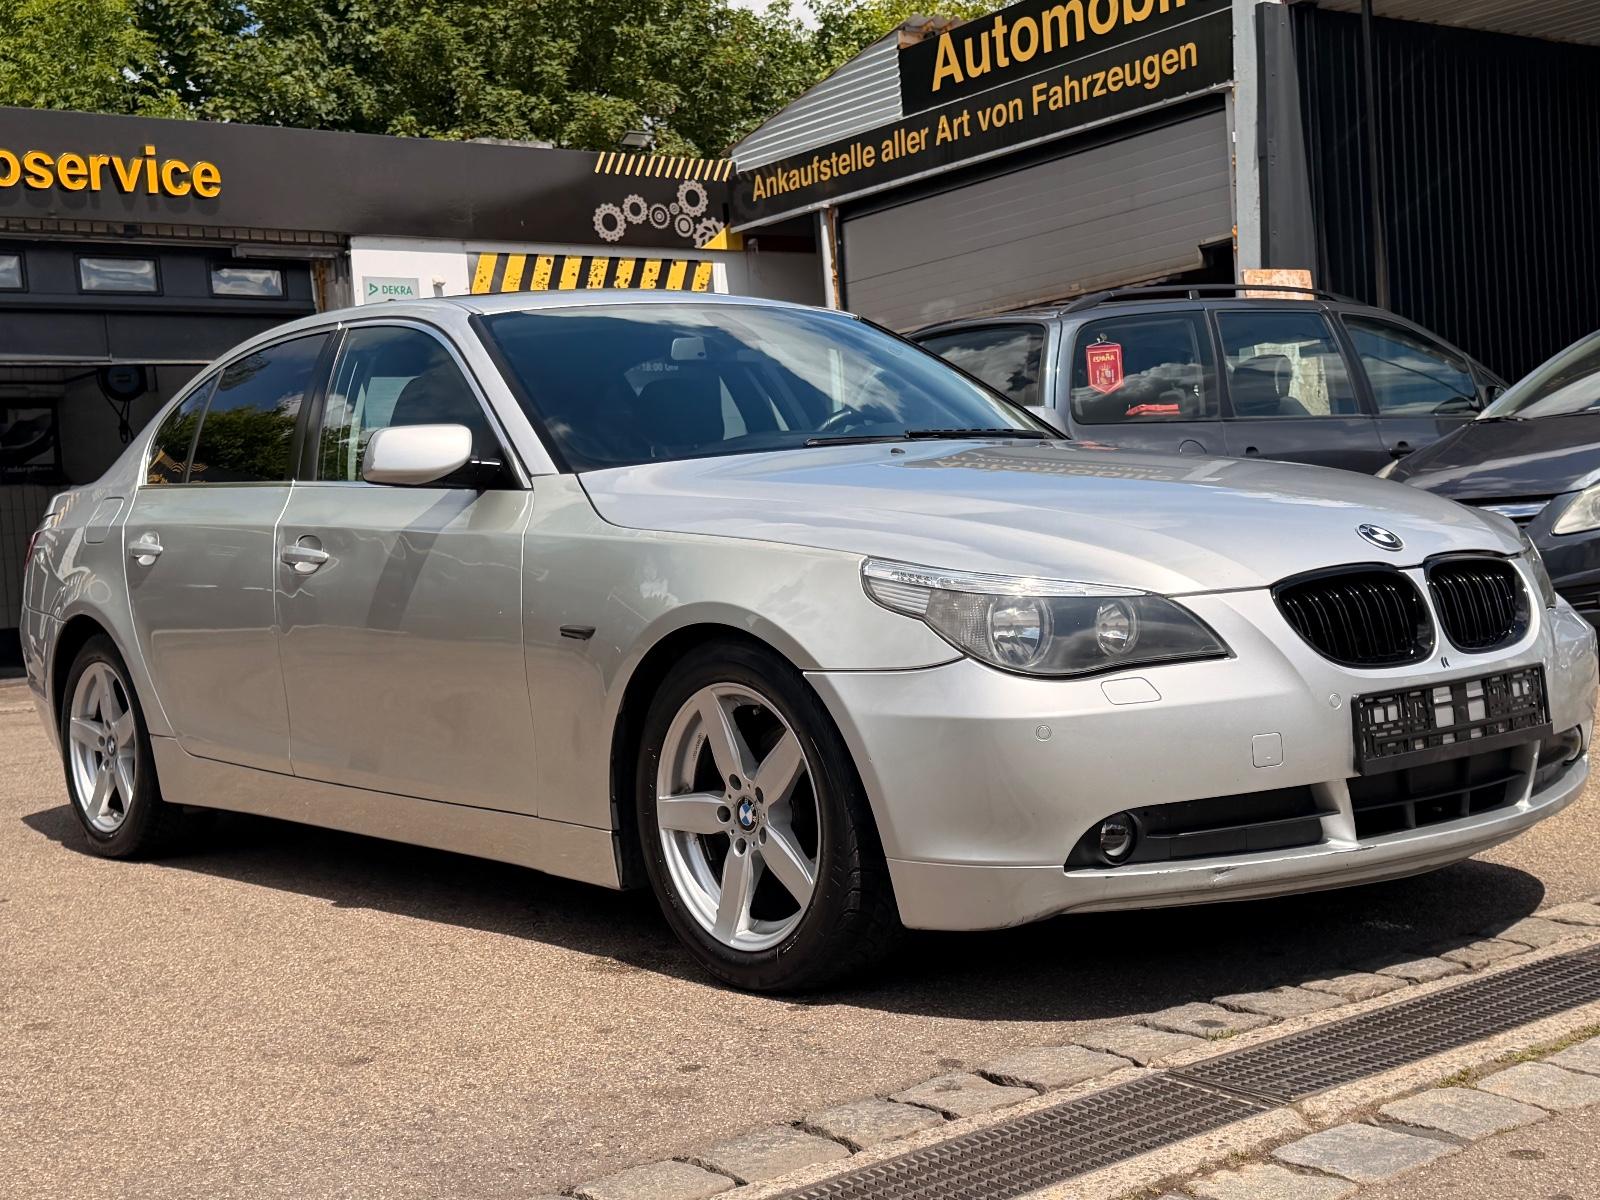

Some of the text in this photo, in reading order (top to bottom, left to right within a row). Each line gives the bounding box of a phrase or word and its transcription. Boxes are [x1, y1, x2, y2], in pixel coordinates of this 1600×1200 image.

[932, 0, 1186, 91] Automo
[752, 41, 1198, 201] Ankaufstelle aller Art von Fahrzeugen
[0, 144, 222, 198] oservice
[382, 284, 414, 296] DEKRA
